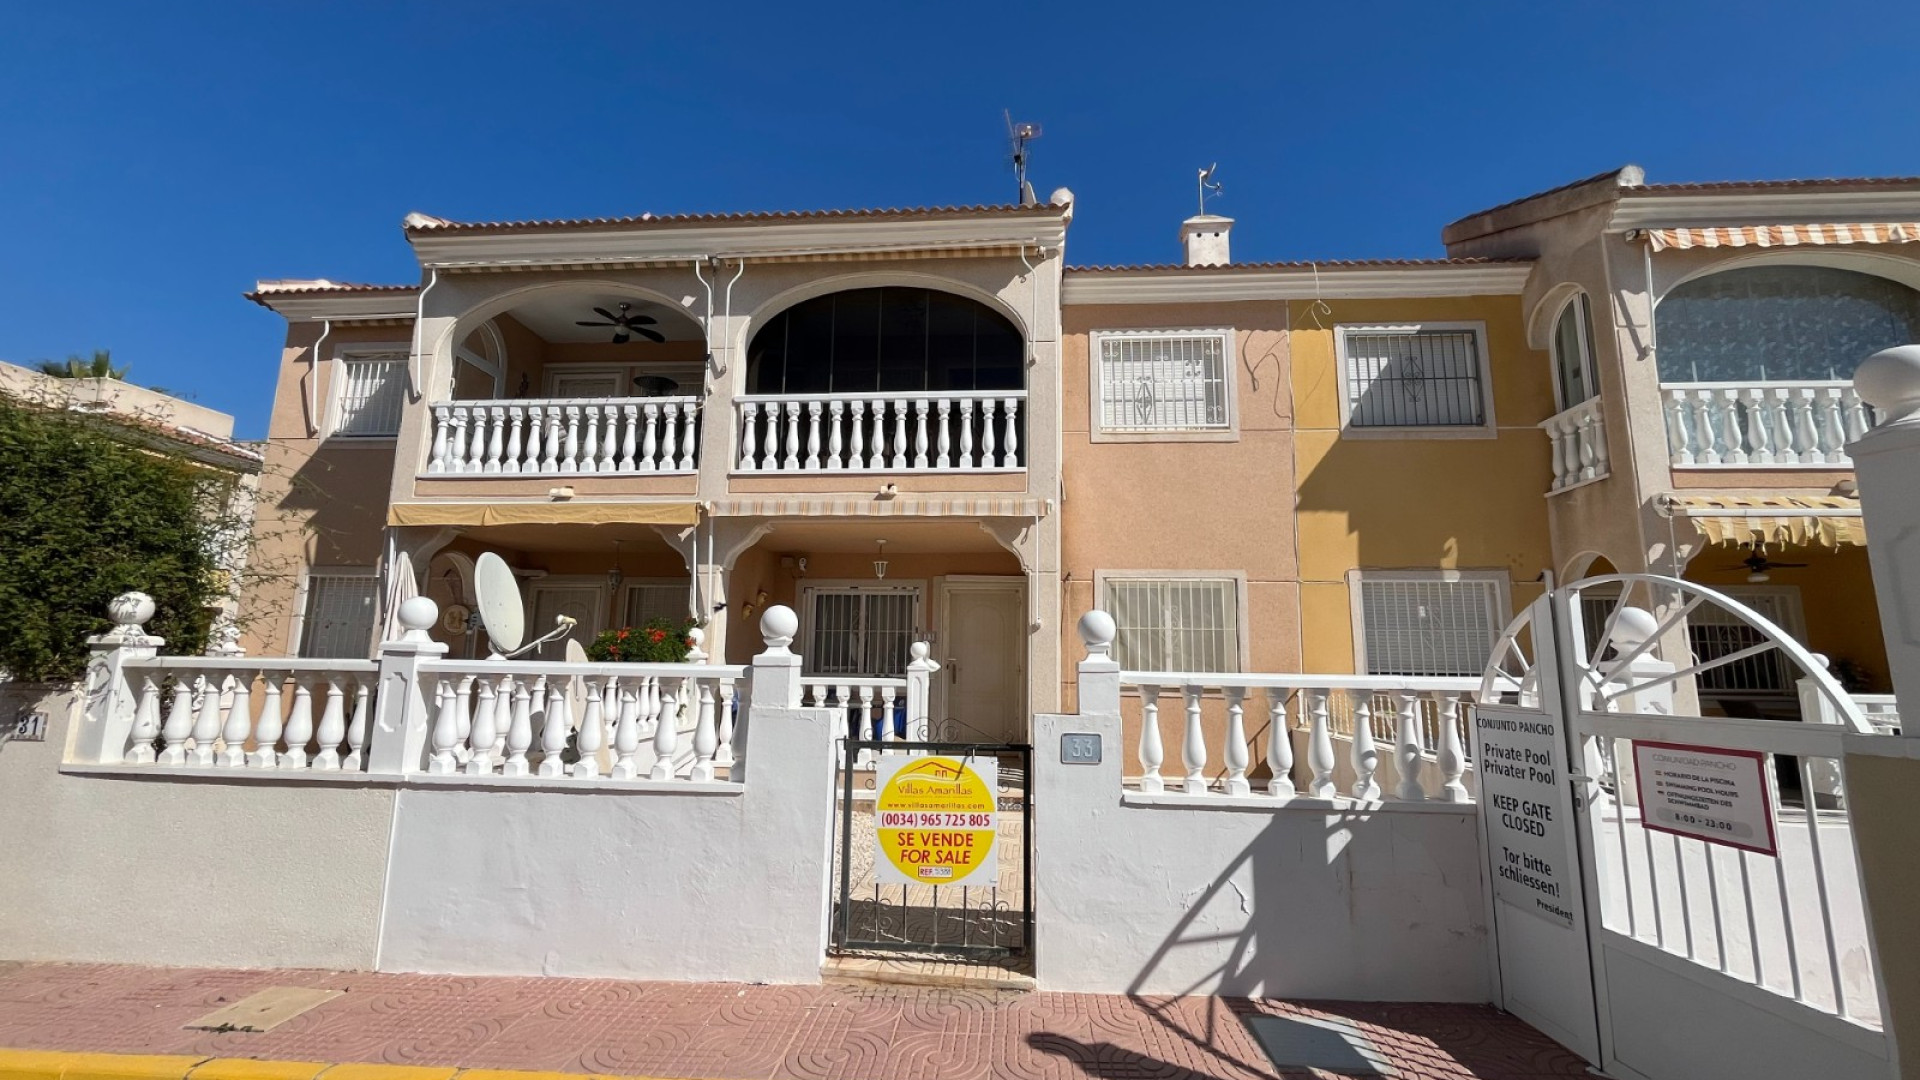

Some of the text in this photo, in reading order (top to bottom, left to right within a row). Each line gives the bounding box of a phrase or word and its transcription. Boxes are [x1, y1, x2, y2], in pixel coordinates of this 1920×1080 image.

[19, 716, 38, 735] 31
[1477, 717, 1554, 736] CONJUNTO PANCHO
[1072, 738, 1093, 757] 33
[1484, 743, 1551, 766] Private Pool
[1484, 760, 1555, 785] Privater Pool
[898, 783, 973, 795] Villas Amarillas
[1493, 794, 1552, 821] KEEP GATE
[881, 813, 990, 828] (0034) 965 725 805
[1502, 813, 1545, 837] CLOSED
[898, 832, 973, 847] SE VENDE
[900, 850, 971, 864] FOR SALE
[1502, 847, 1552, 876] Tor bitte
[1499, 864, 1560, 898] schliessen!
[1536, 899, 1574, 921] President
